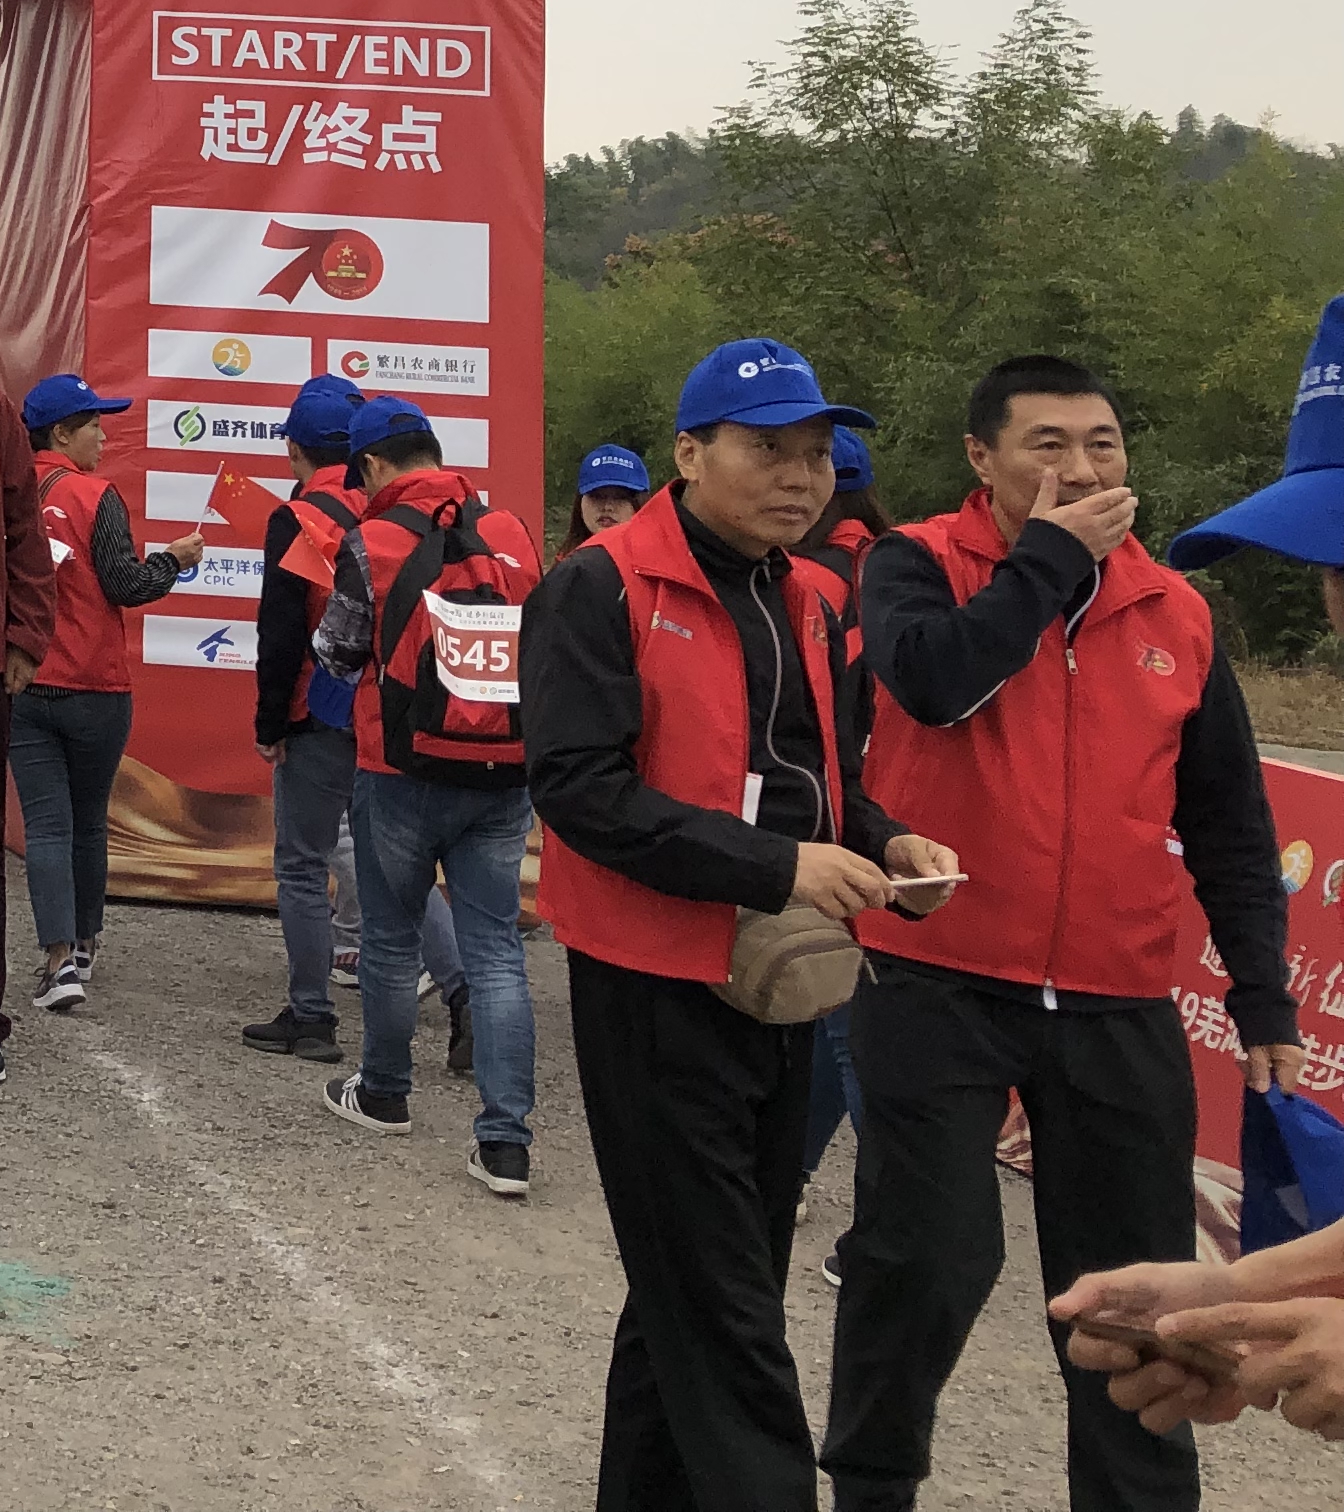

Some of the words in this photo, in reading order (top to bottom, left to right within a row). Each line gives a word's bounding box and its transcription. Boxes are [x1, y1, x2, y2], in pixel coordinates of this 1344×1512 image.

[170, 25, 473, 80] START/END
[199, 94, 443, 174] 起/终点
[376, 354, 476, 374] 繁昌农商银行
[203, 574, 236, 586] CPIC
[437, 626, 510, 673] 0545
